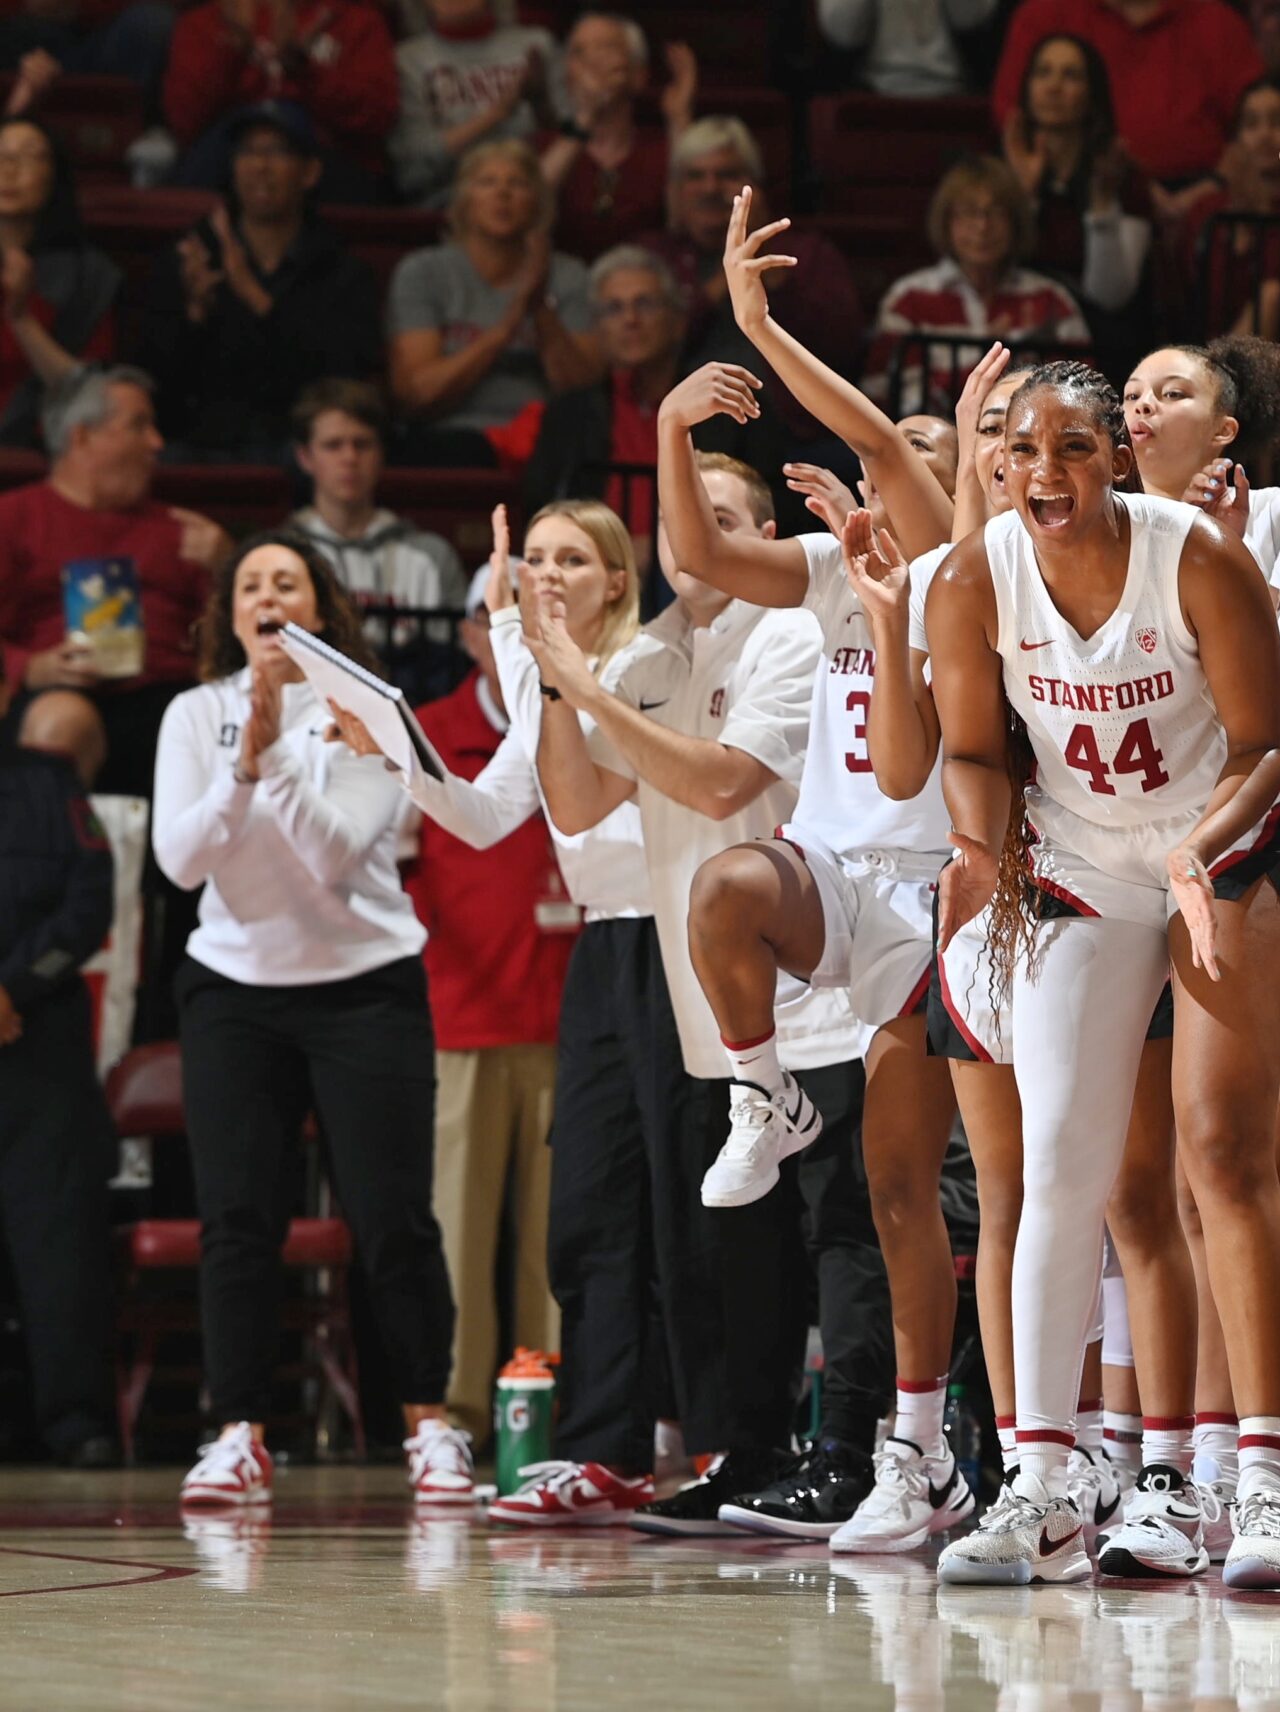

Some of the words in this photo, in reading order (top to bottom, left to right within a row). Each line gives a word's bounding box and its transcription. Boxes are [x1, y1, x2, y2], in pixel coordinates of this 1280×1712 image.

[1028, 670, 1175, 712] STANFORD
[1064, 717, 1170, 796] 44
[506, 1398, 530, 1432] G
